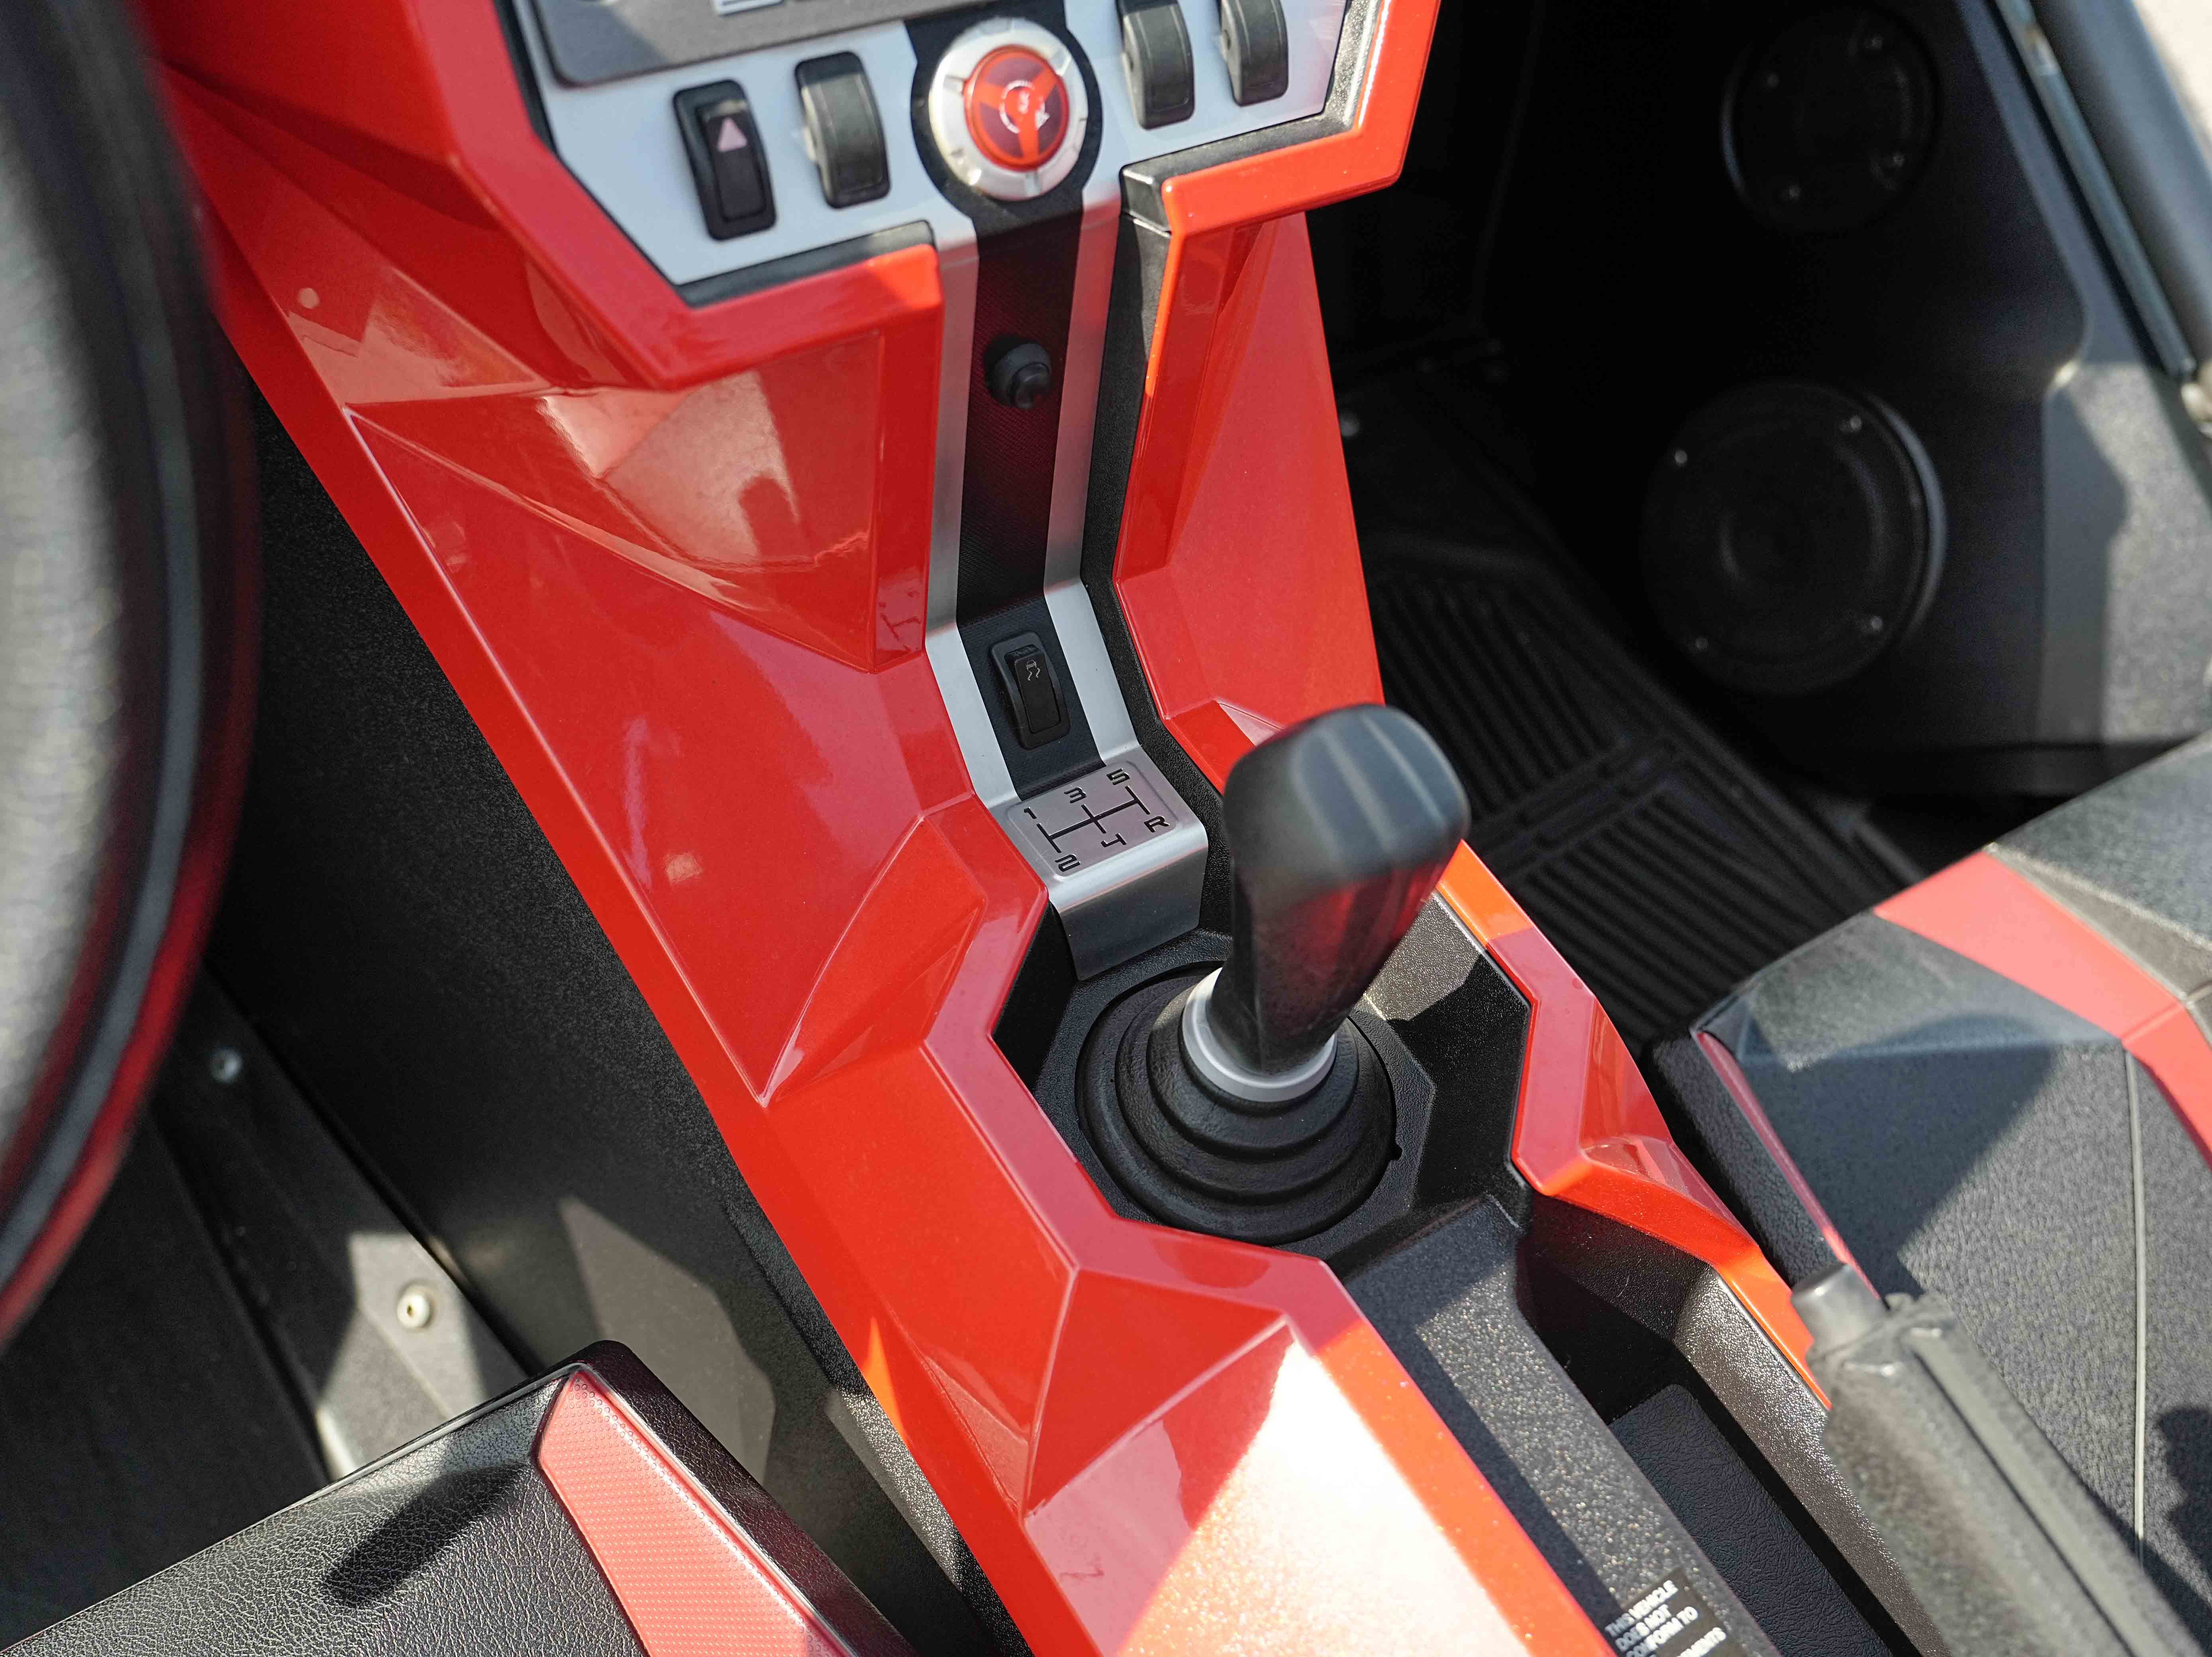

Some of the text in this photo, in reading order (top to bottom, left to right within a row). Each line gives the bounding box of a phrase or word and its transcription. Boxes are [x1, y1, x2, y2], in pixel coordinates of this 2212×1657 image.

[1024, 768, 1130, 819] 1 3 5
[1055, 815, 1170, 872] 2 4 R
[1604, 1580, 1679, 1637] THIS VEHICLE
[1615, 1622, 1650, 1652] DOES
[1644, 1604, 1672, 1631] NOT
[1677, 1606, 1698, 1625] TO
